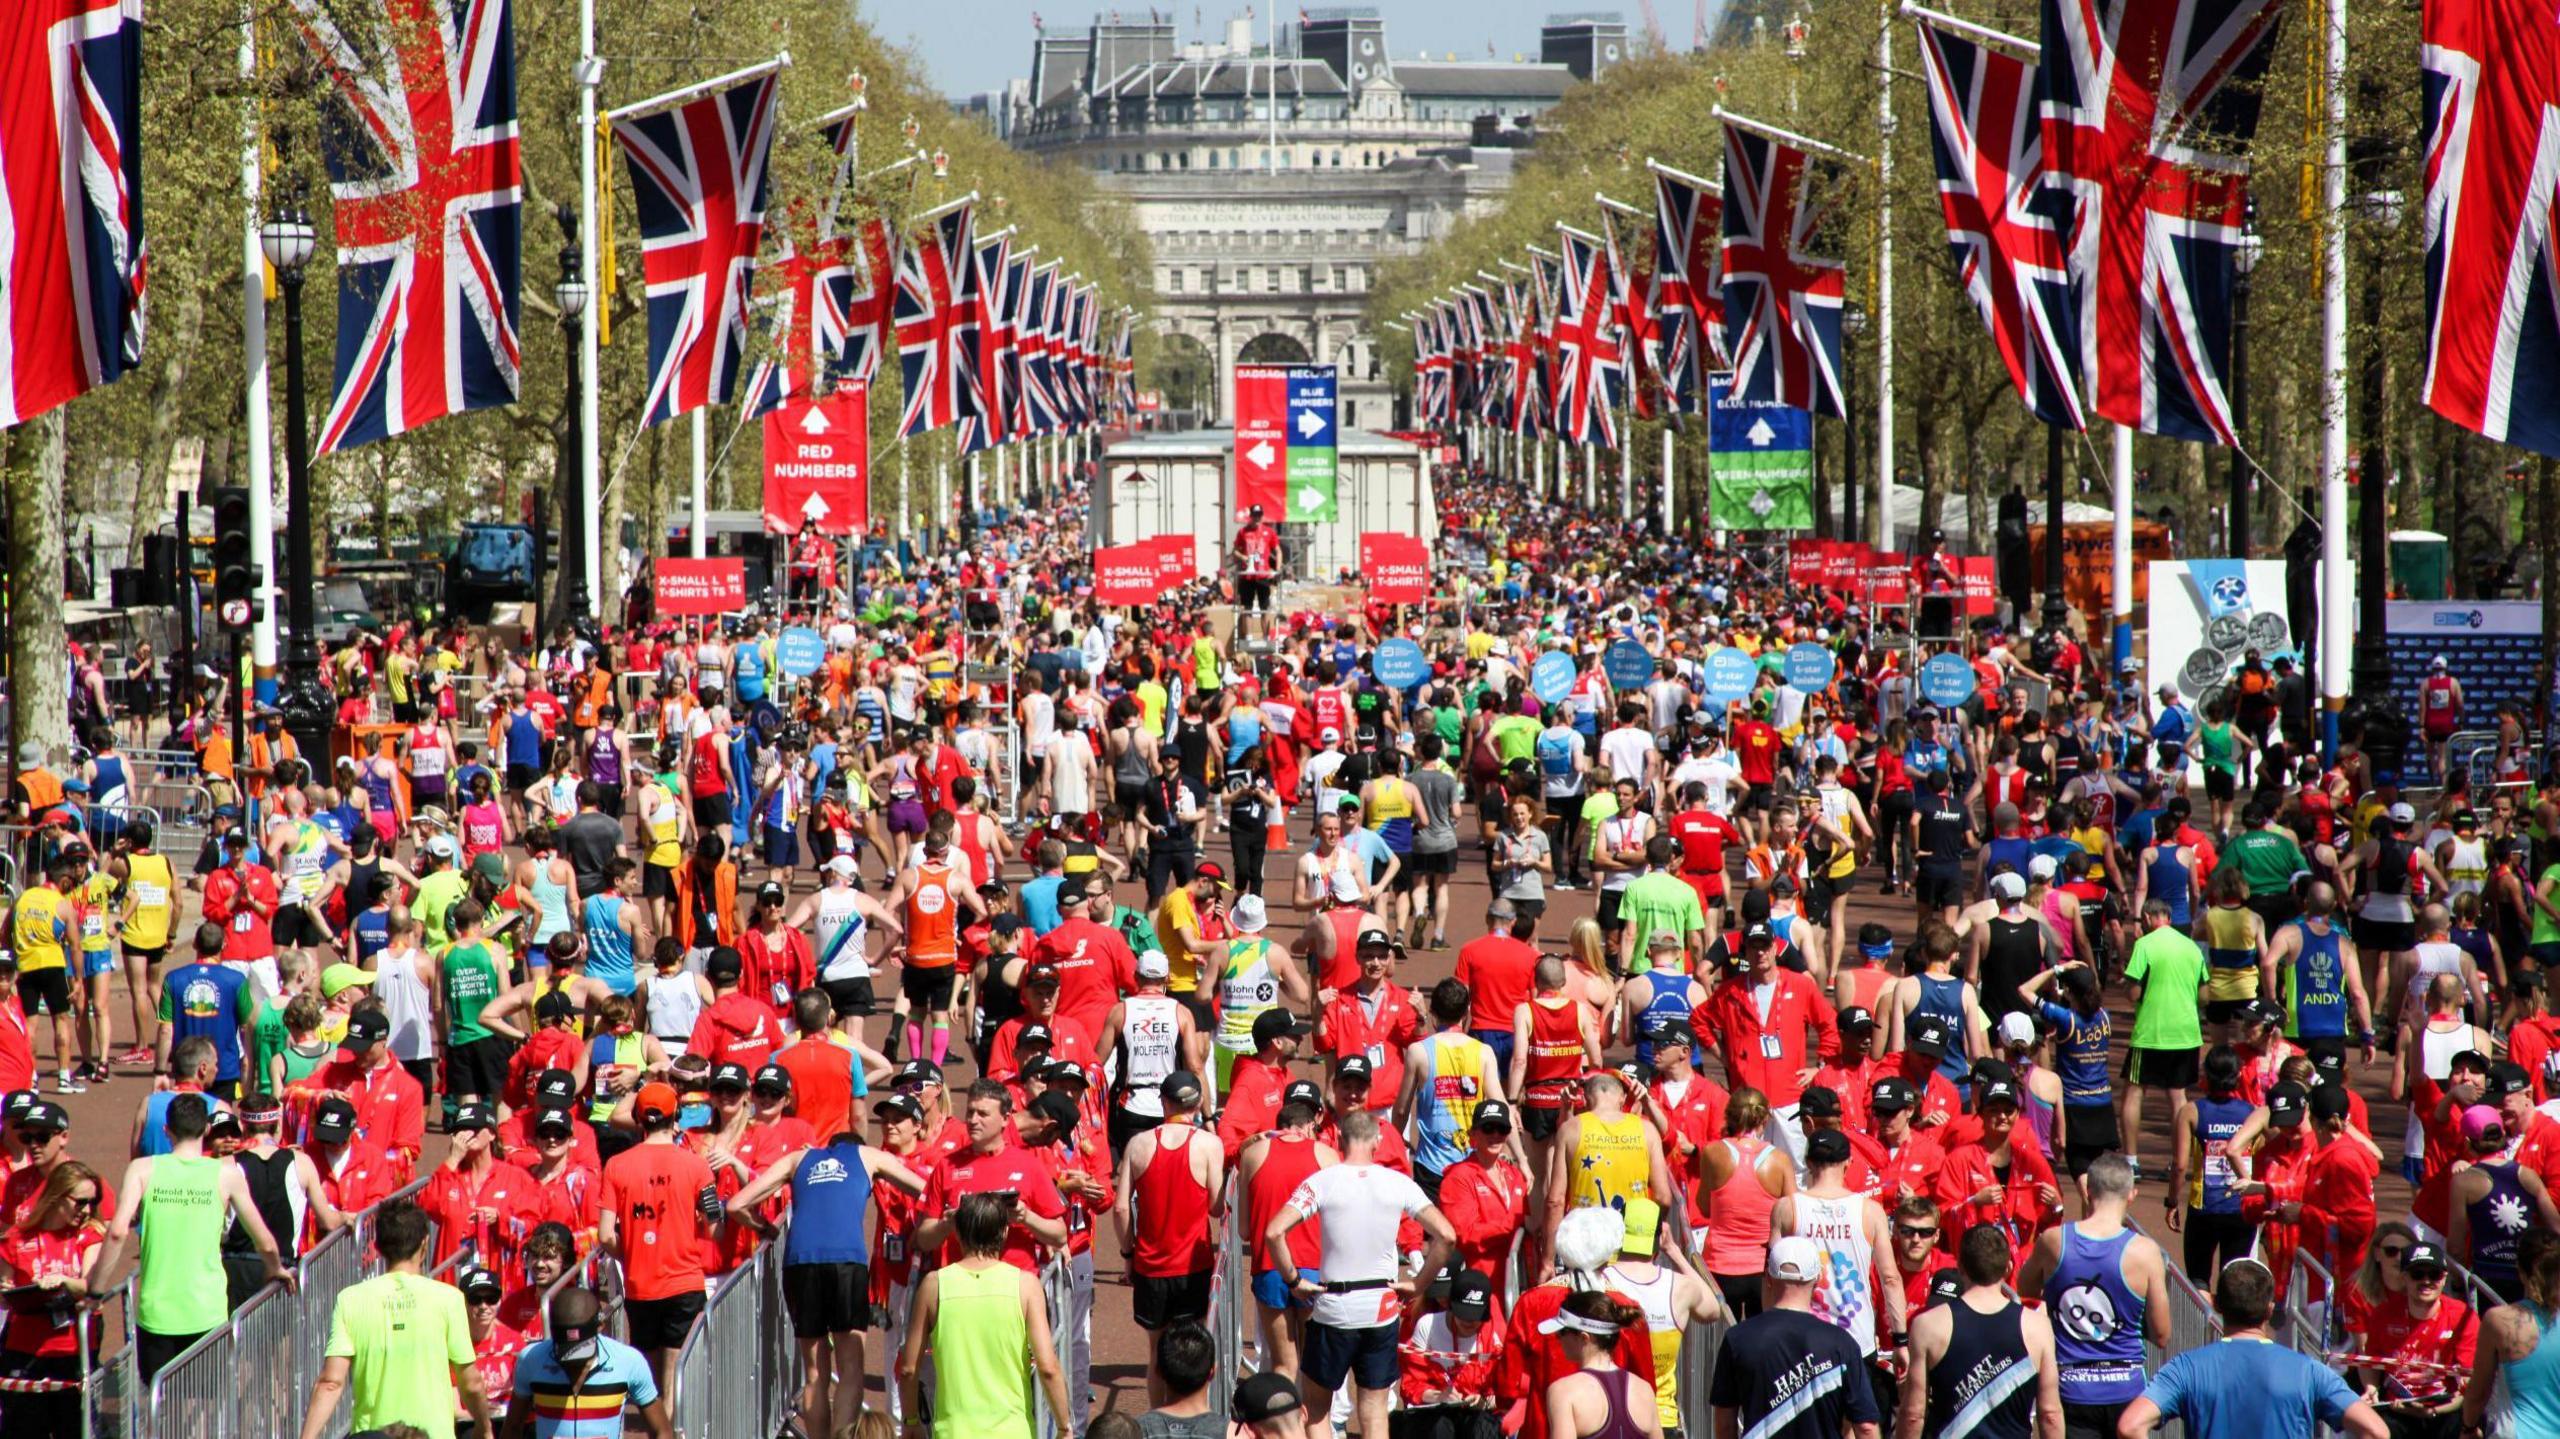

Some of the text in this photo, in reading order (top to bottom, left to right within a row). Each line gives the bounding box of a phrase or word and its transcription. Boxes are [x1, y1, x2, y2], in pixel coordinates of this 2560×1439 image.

[1300, 387, 1325, 397] BLUE
[1290, 398, 1334, 407] NUMBERS
[1717, 399, 1741, 410] BLUE
[798, 444, 833, 459] RED
[774, 463, 857, 479] NUMBERS
[1103, 566, 1153, 577] X-SMALL
[659, 575, 708, 586] X-SMALL
[1103, 577, 1154, 589] T-SHIRTS
[1857, 577, 1904, 589] T-SHIRTS
[659, 587, 709, 598] T-SHIRTS
[822, 915, 853, 926] PAUL
[1232, 984, 1254, 994] John
[2303, 992, 2340, 1005] ANDY
[1133, 1019, 1170, 1036] FREE
[1133, 1044, 1170, 1057] MOLFETTA
[2208, 1123, 2243, 1134] LONDO
[1584, 1133, 1641, 1144] STARLIGHT
[153, 1187, 213, 1197] Harold Wood
[152, 1195, 212, 1206] Running Club
[1806, 1223, 1851, 1240] JAMIE
[1954, 1354, 1996, 1397] HART
[1973, 1356, 2013, 1394] RUNNERS
[2101, 1371, 2131, 1382] HERE
